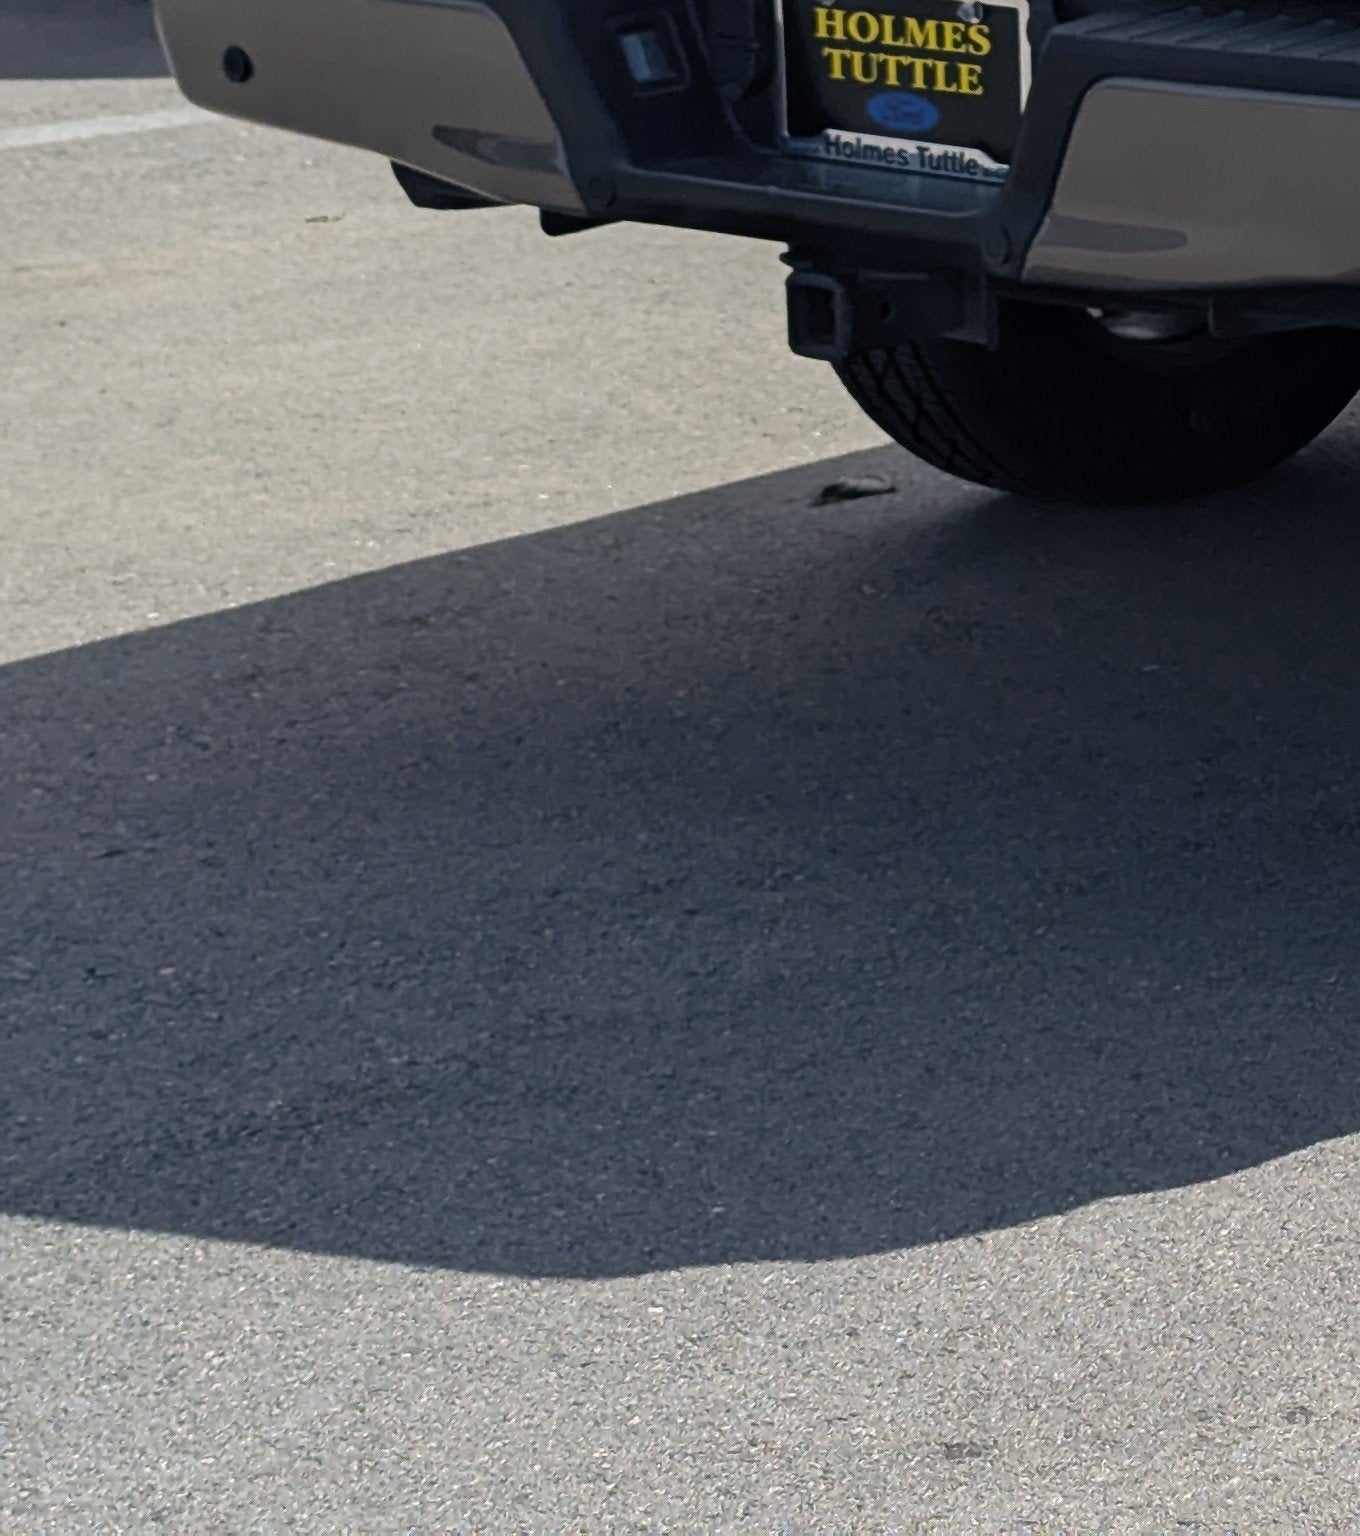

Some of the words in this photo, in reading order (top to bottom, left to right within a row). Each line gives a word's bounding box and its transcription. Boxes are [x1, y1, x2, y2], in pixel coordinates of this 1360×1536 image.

[814, 5, 991, 56] HOLMES
[821, 46, 984, 96] TUTTLE
[824, 132, 909, 165] Holmes
[914, 139, 979, 176] Tuttle
